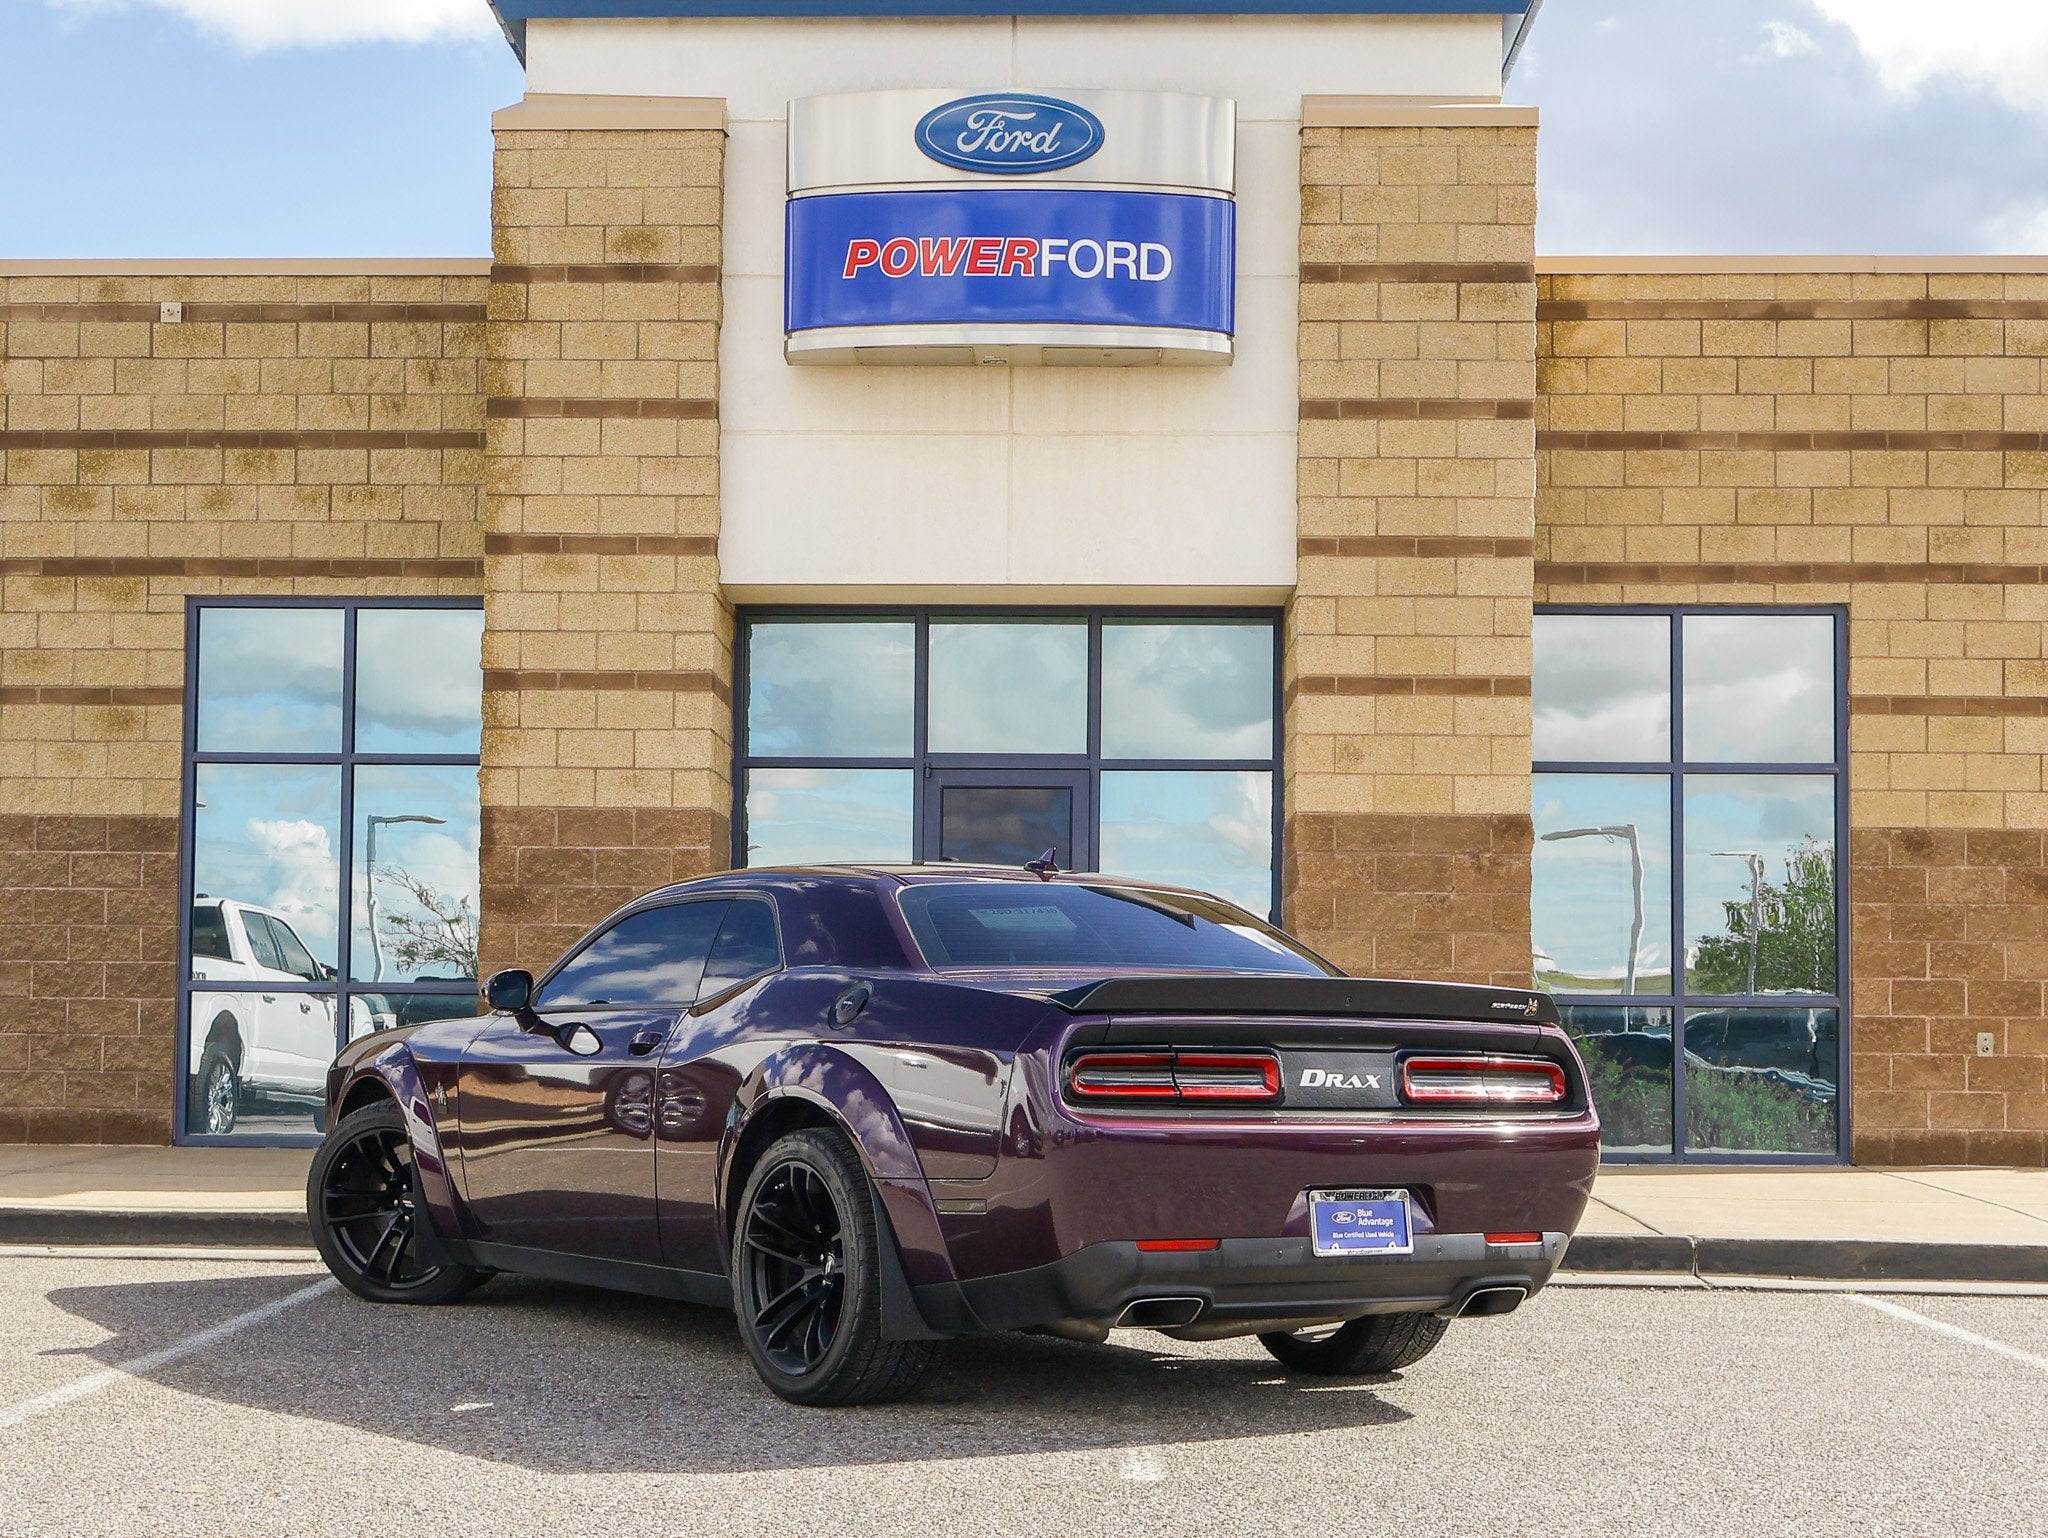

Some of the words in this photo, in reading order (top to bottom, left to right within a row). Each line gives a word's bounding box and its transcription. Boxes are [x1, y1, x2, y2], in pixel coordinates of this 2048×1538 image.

[957, 109, 1063, 154] Ford
[1357, 1208, 1373, 1217] Blue
[1358, 1217, 1394, 1227] Advantage
